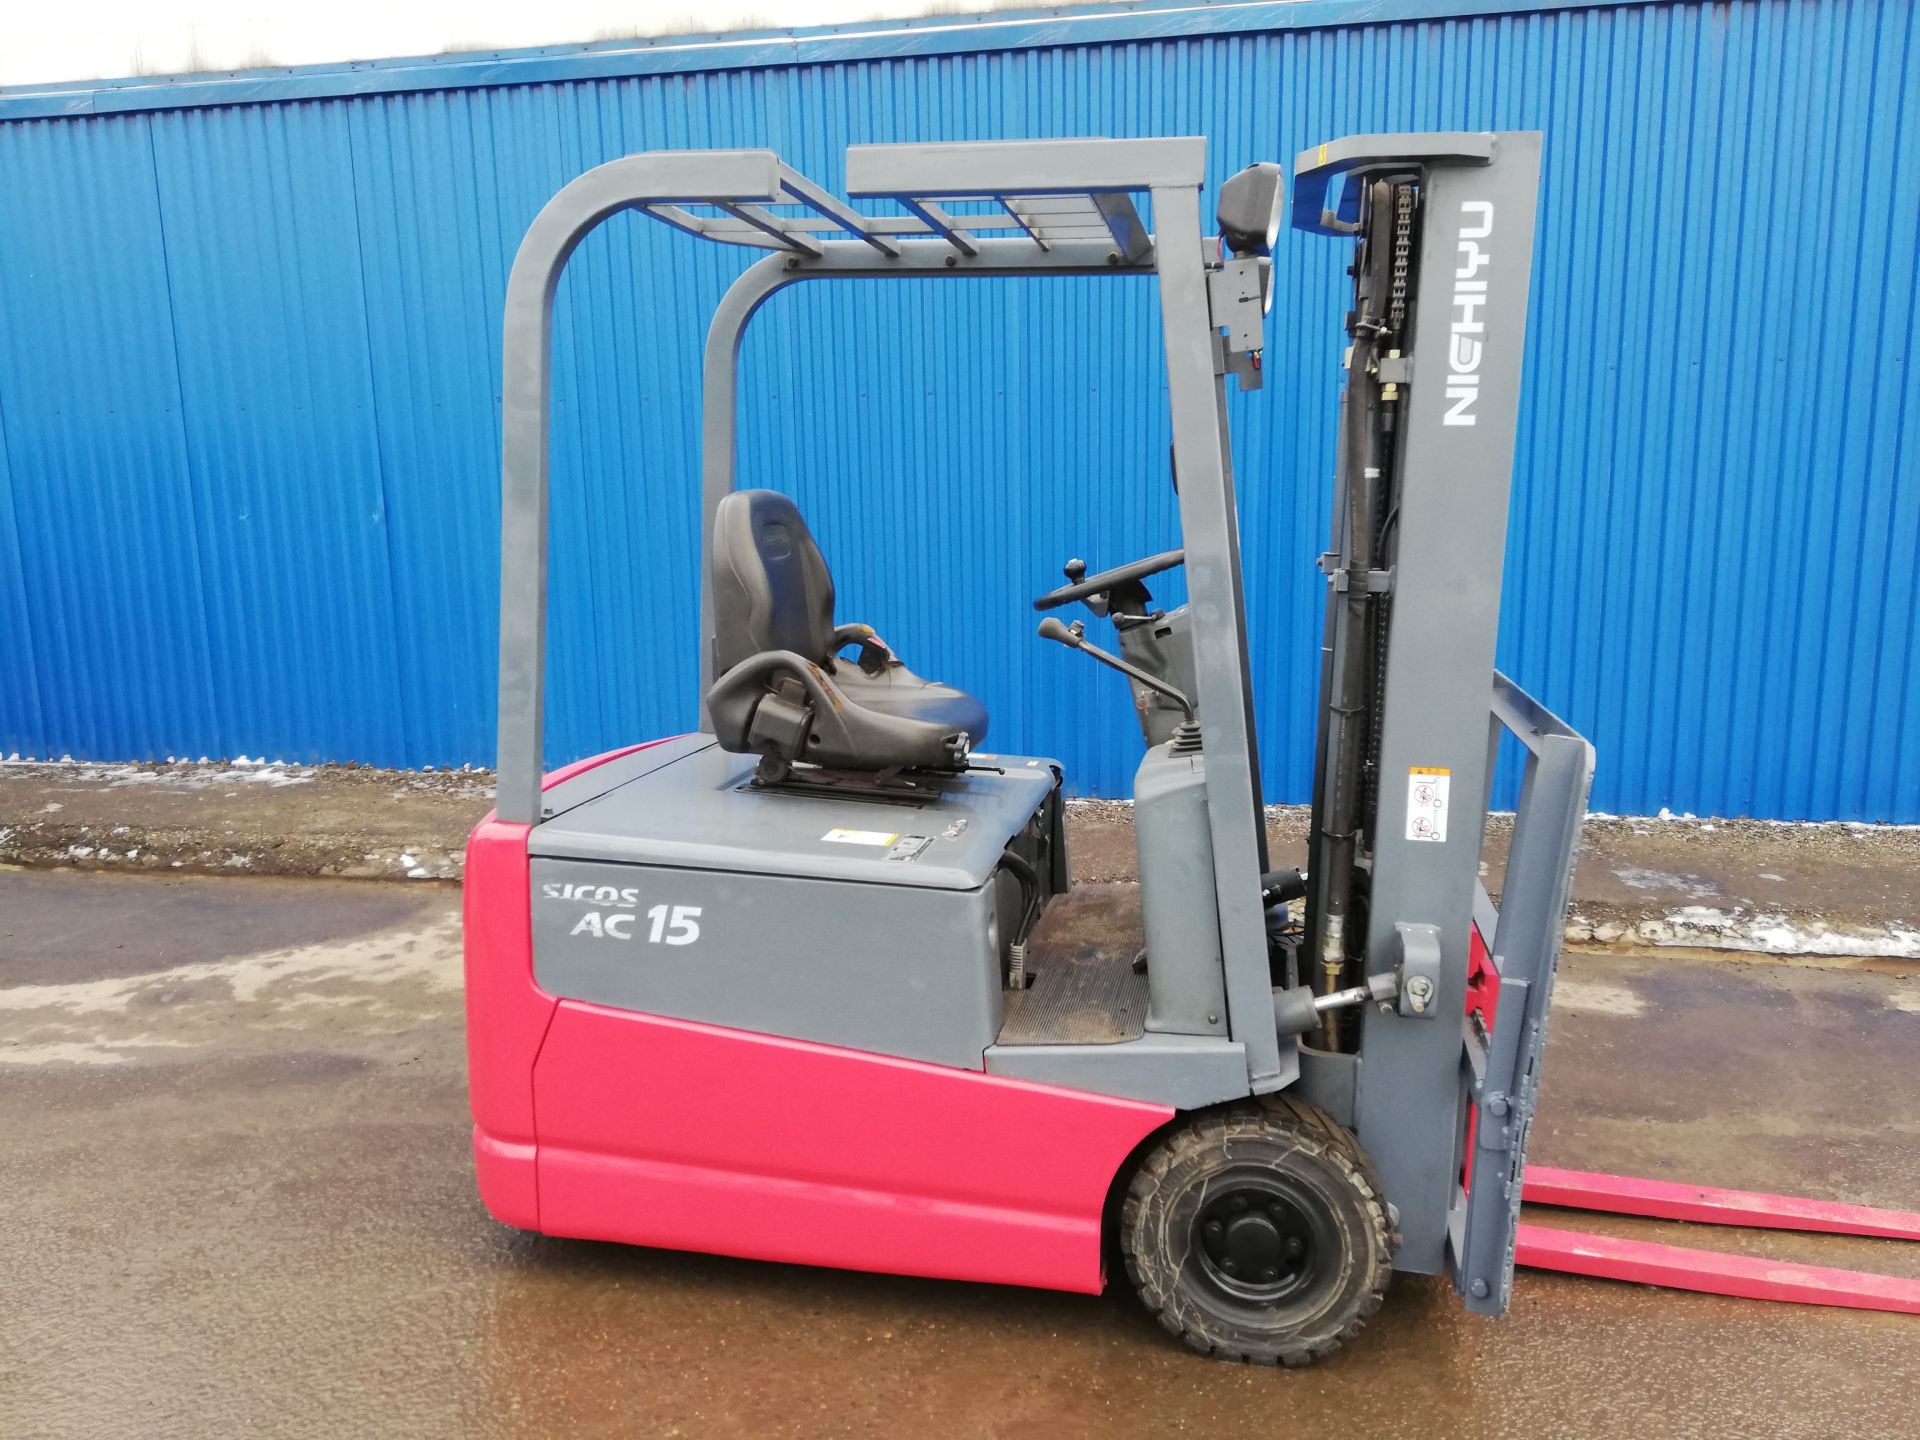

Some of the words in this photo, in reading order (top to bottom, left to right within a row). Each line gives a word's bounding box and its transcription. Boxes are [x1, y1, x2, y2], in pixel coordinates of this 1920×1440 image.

[1442, 200, 1495, 426] NICHIYU
[569, 911, 636, 940] AC
[647, 904, 703, 946] 15
